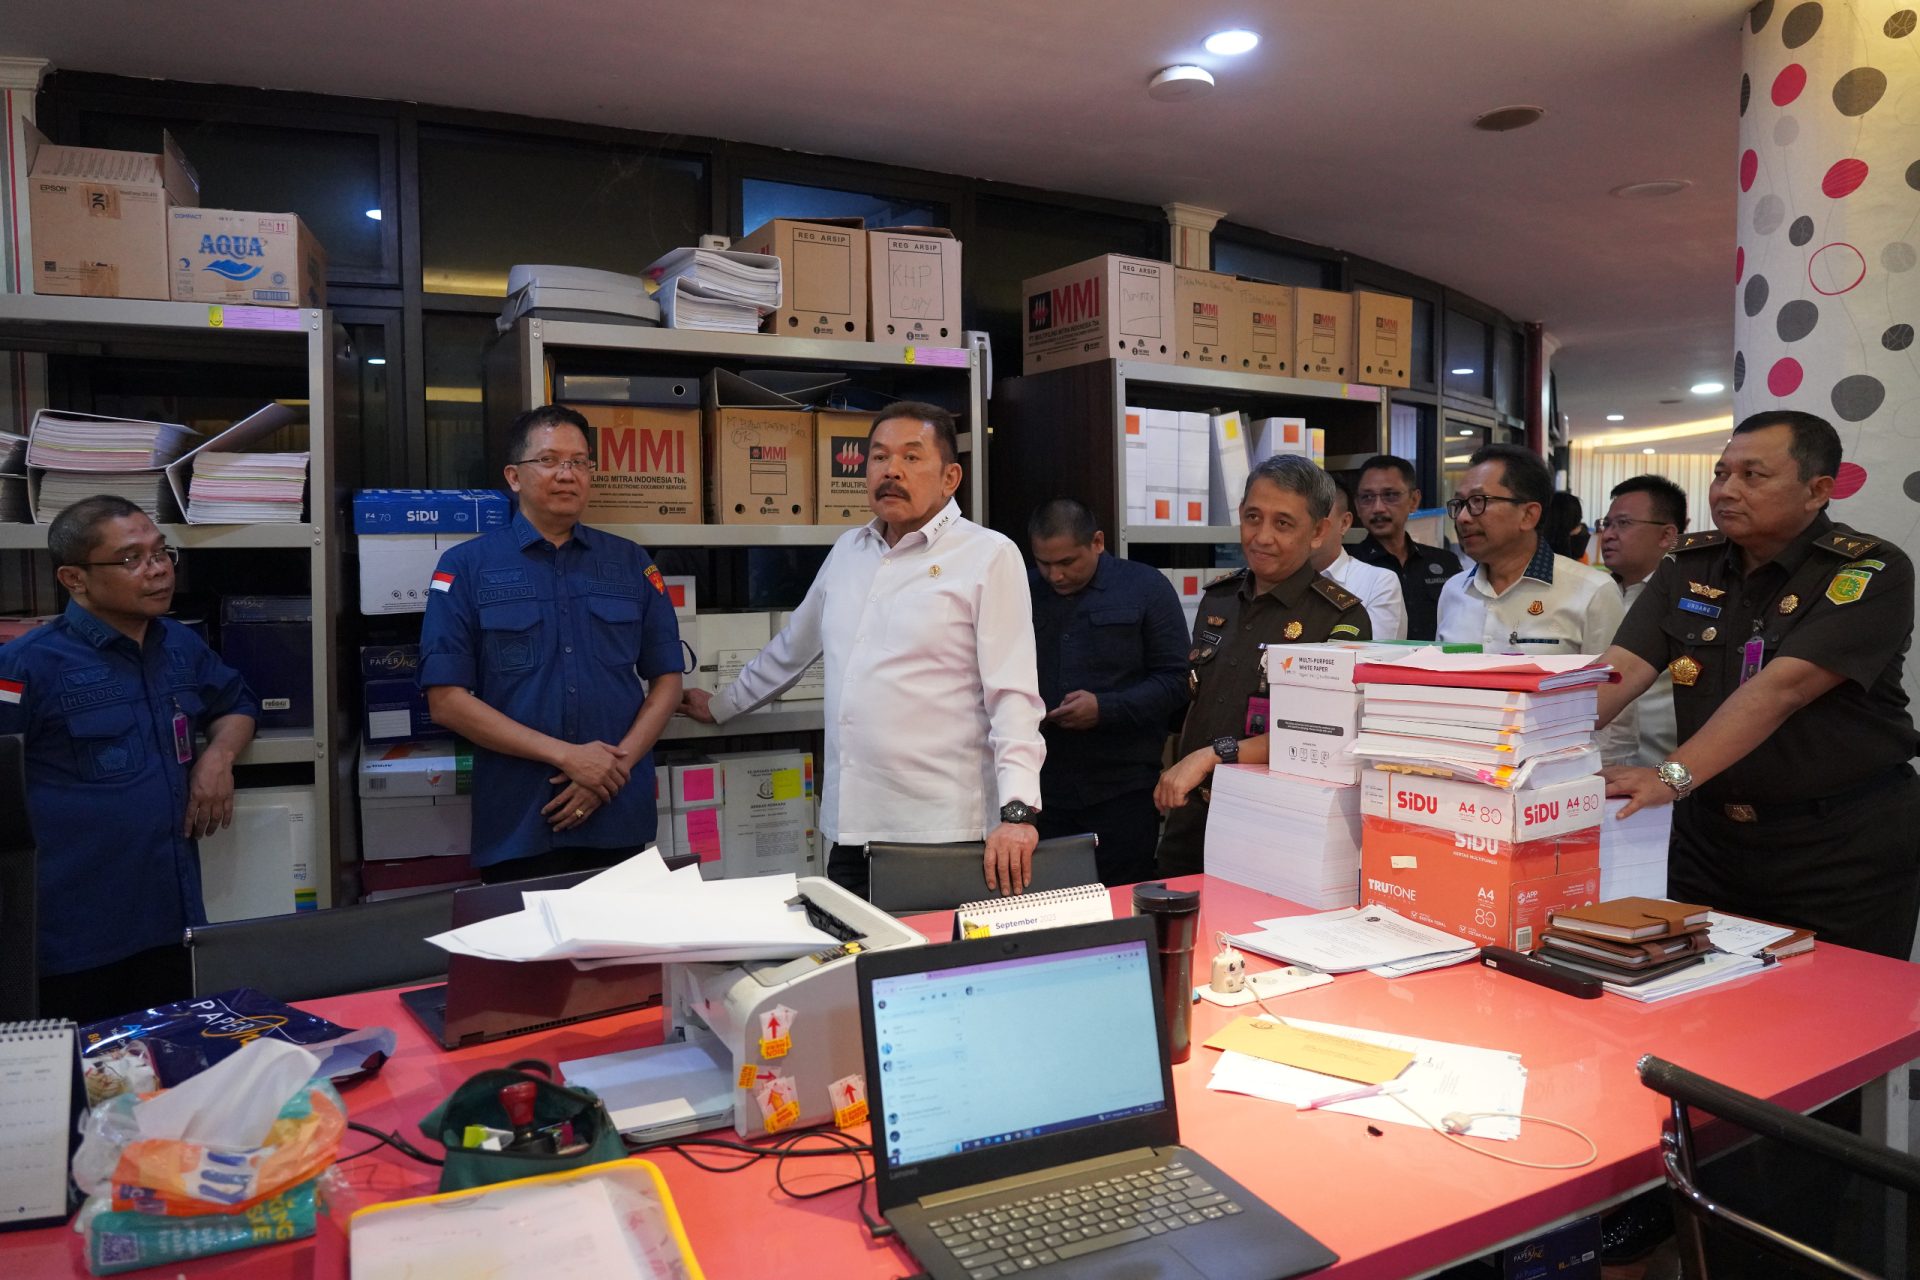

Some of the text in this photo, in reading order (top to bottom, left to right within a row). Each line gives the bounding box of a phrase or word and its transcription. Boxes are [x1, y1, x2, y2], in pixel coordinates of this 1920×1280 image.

[40, 184, 67, 193] EPSON
[798, 232, 846, 243] REG ARSIP
[199, 234, 265, 259] AQUA
[914, 243, 937, 251] ARSIP
[892, 264, 932, 288] KHP
[1139, 266, 1157, 274] ARSIP
[1052, 277, 1100, 328] MMI
[1201, 303, 1218, 316] MMI
[1260, 313, 1277, 327] MMI
[1320, 314, 1336, 328] MMI
[601, 427, 685, 474] MMI
[762, 446, 787, 460] MMI
[611, 475, 633, 483] MITRA
[634, 476, 672, 484] INDONESIA
[406, 510, 439, 522] SiDU
[370, 657, 399, 666] PAPER
[1299, 657, 1335, 666] MULTI-PURPOSE
[1397, 790, 1438, 815] SiDU
[1458, 801, 1476, 815] A4
[1480, 806, 1502, 825] 80
[1524, 793, 1599, 827] SiDU A4 80
[1368, 878, 1416, 901] TRUTONE
[1477, 887, 1495, 901] A4
[1525, 890, 1538, 899] APP
[995, 917, 1038, 930] September
[1475, 908, 1497, 928] 80
[189, 1000, 257, 1032] PAPER
